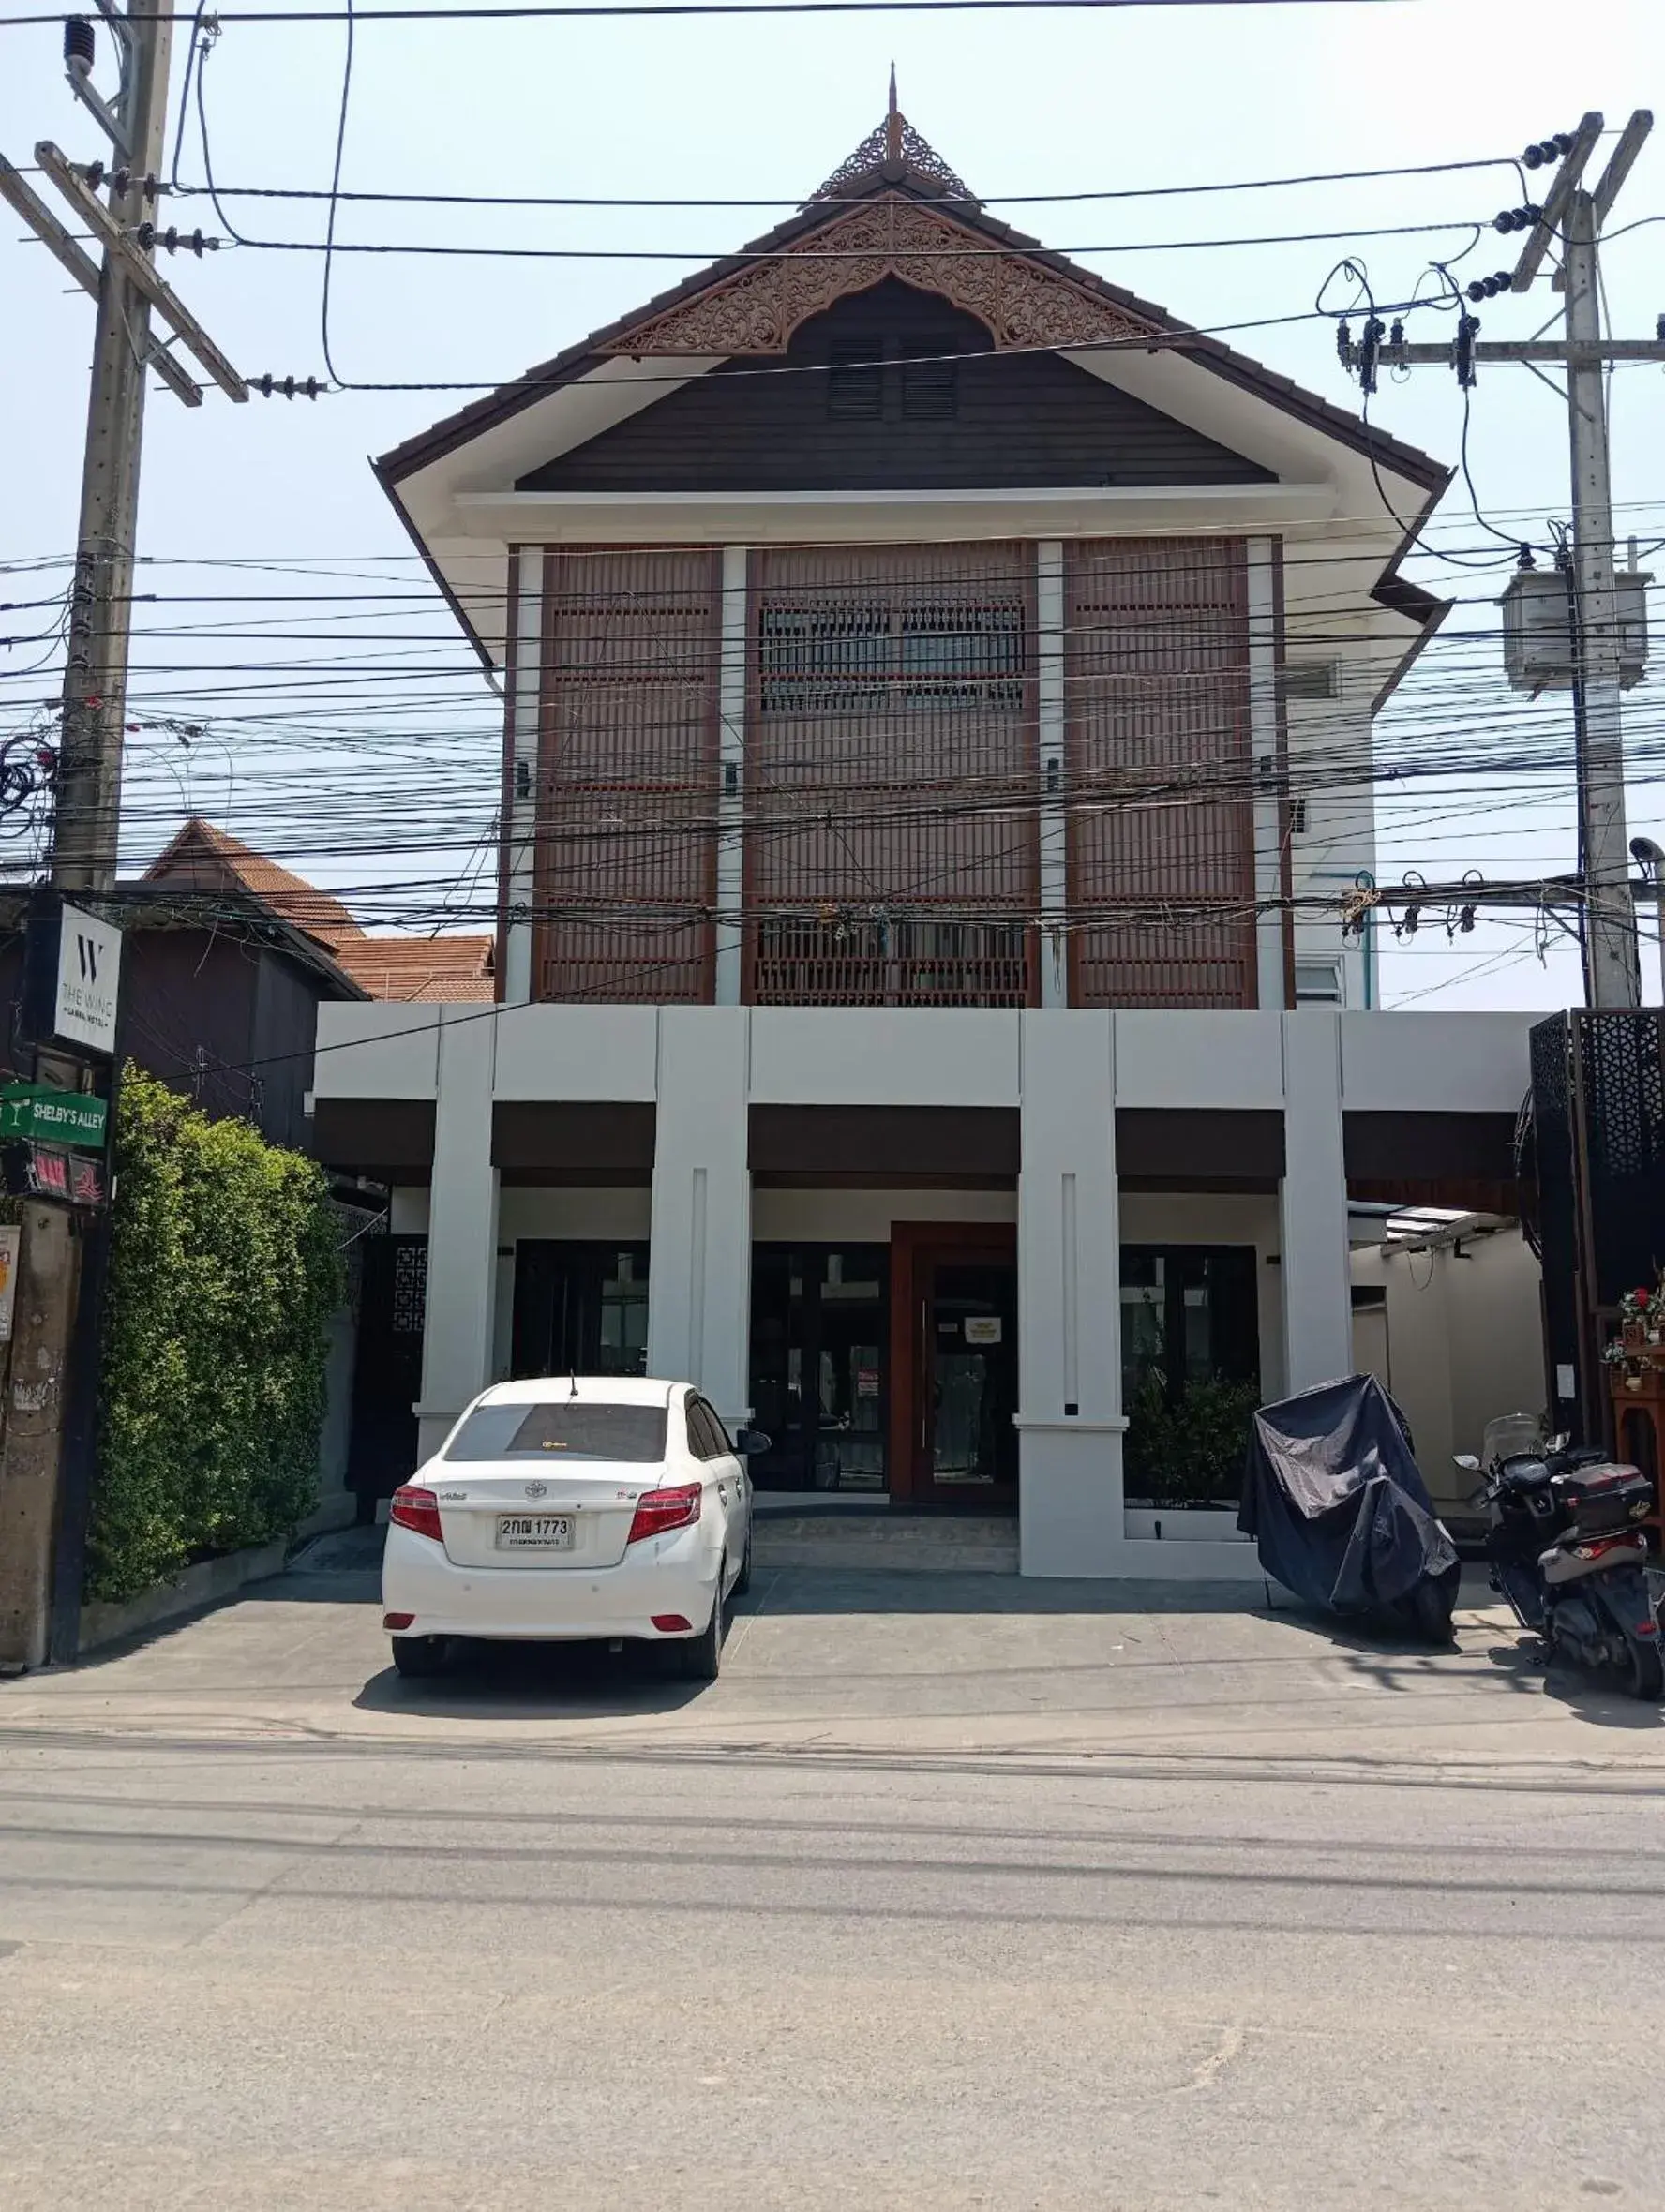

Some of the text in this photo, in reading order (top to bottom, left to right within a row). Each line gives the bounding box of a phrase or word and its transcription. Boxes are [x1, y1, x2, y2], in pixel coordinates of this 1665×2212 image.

[33, 1102, 105, 1129] SHELBY'S ALLEY
[535, 1519, 567, 1534] 1773
